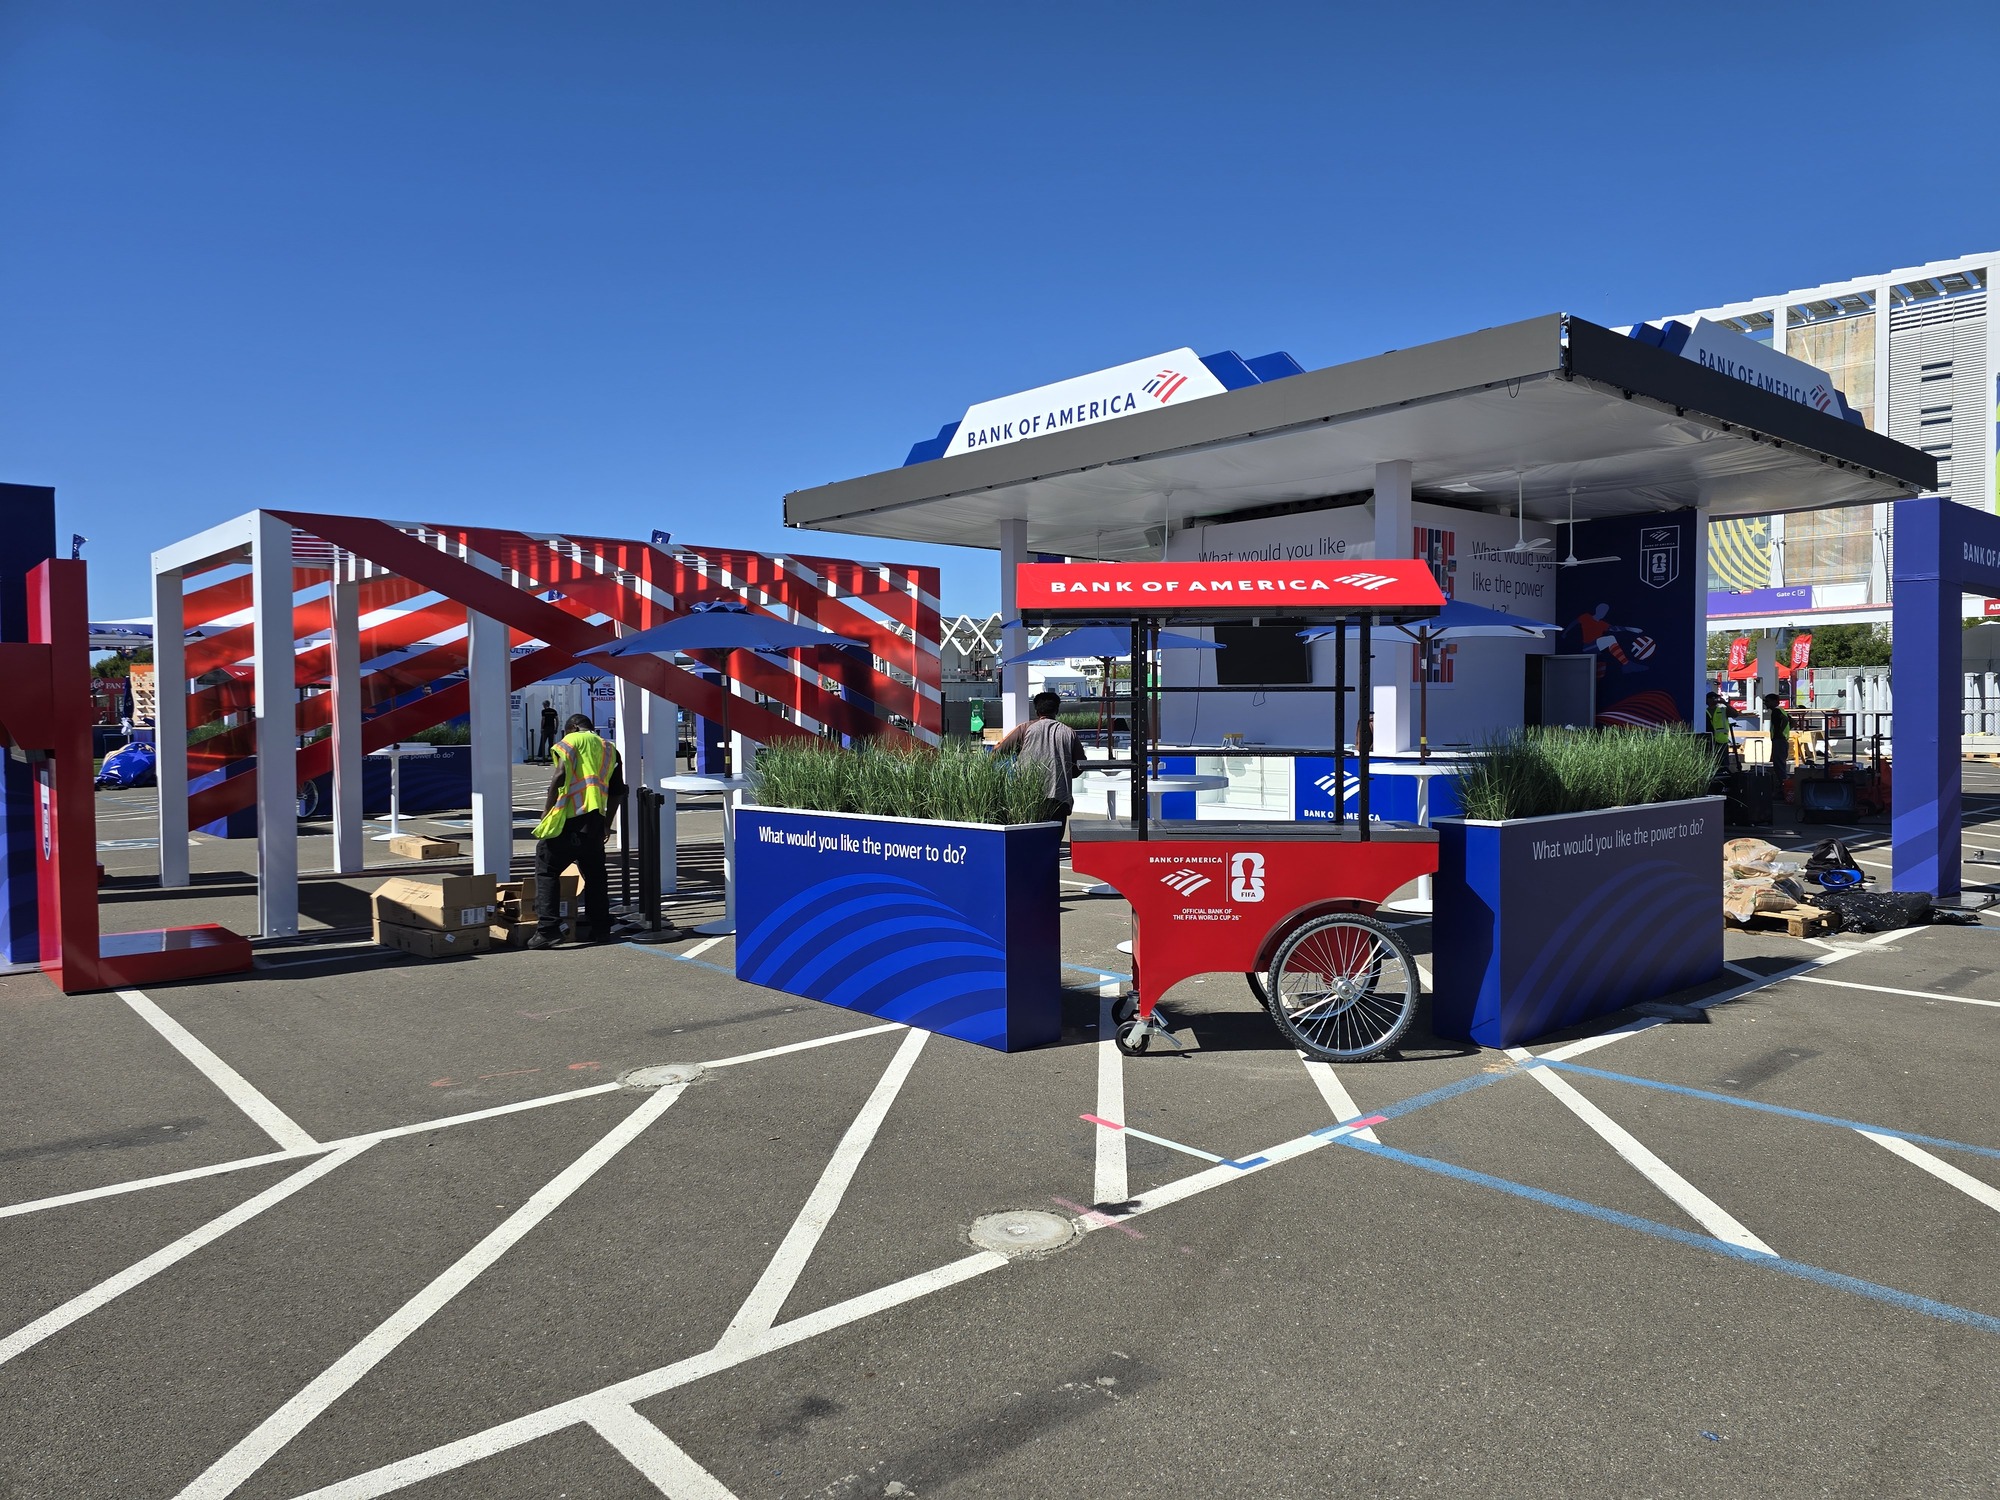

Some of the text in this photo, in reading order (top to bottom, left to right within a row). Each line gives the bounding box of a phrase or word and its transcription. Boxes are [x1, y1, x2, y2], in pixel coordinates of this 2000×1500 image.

[1699, 348, 1808, 406] BANK OF AMERICA
[967, 392, 1137, 448] BANK OF AMERICA
[1238, 543, 1281, 562] would
[1286, 543, 1314, 562] you
[1319, 537, 1346, 556] like
[1472, 540, 1553, 573] What would you
[1963, 541, 1985, 565] BANK
[1986, 548, 1996, 567] OF
[1051, 579, 1330, 593] BANK OF AMERICA
[1472, 571, 1545, 599] like the power
[587, 687, 616, 697] MES
[1304, 809, 1381, 822] BANK O MECA
[759, 826, 967, 865] What would you like the power to do?
[1532, 818, 1705, 861] What would you like the power to do?
